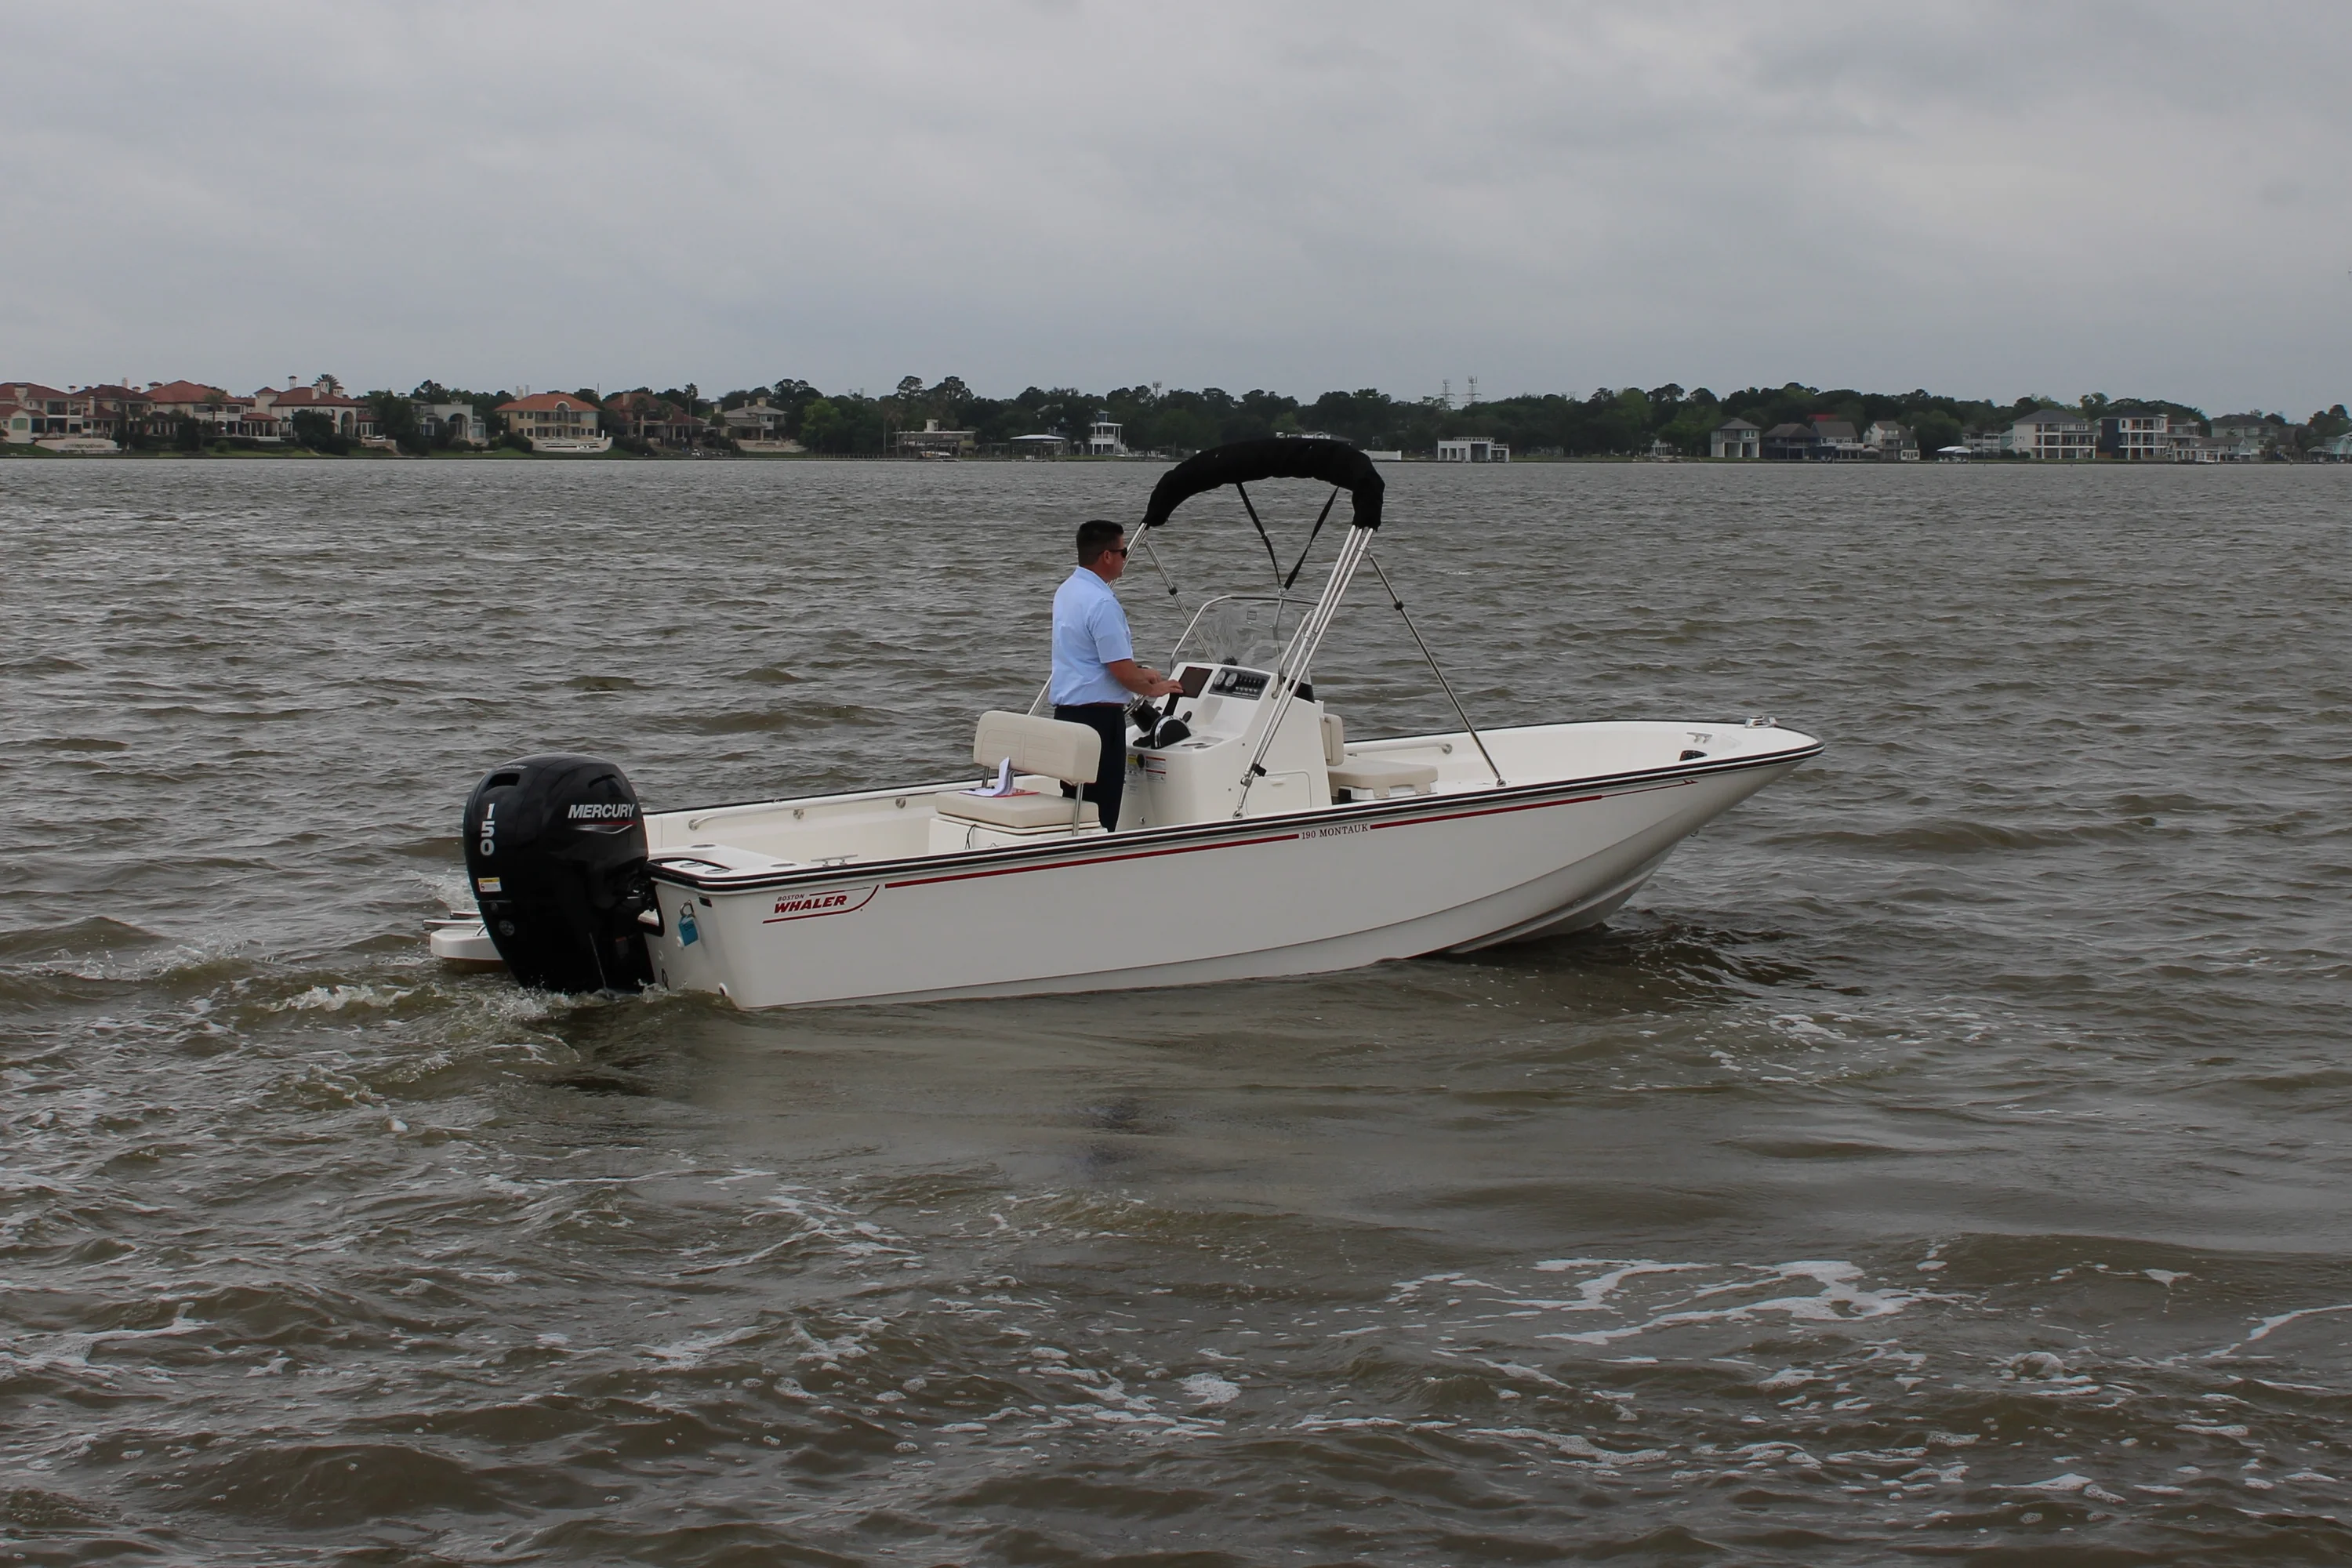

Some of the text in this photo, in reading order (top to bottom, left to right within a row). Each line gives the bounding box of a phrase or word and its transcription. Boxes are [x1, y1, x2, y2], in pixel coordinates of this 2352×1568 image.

[568, 804, 635, 818] MERCURY
[480, 803, 495, 856] 150
[1301, 823, 1368, 840] 190 MONTAUK
[774, 895, 848, 914] WHALER
[777, 893, 805, 902] BOSTON
